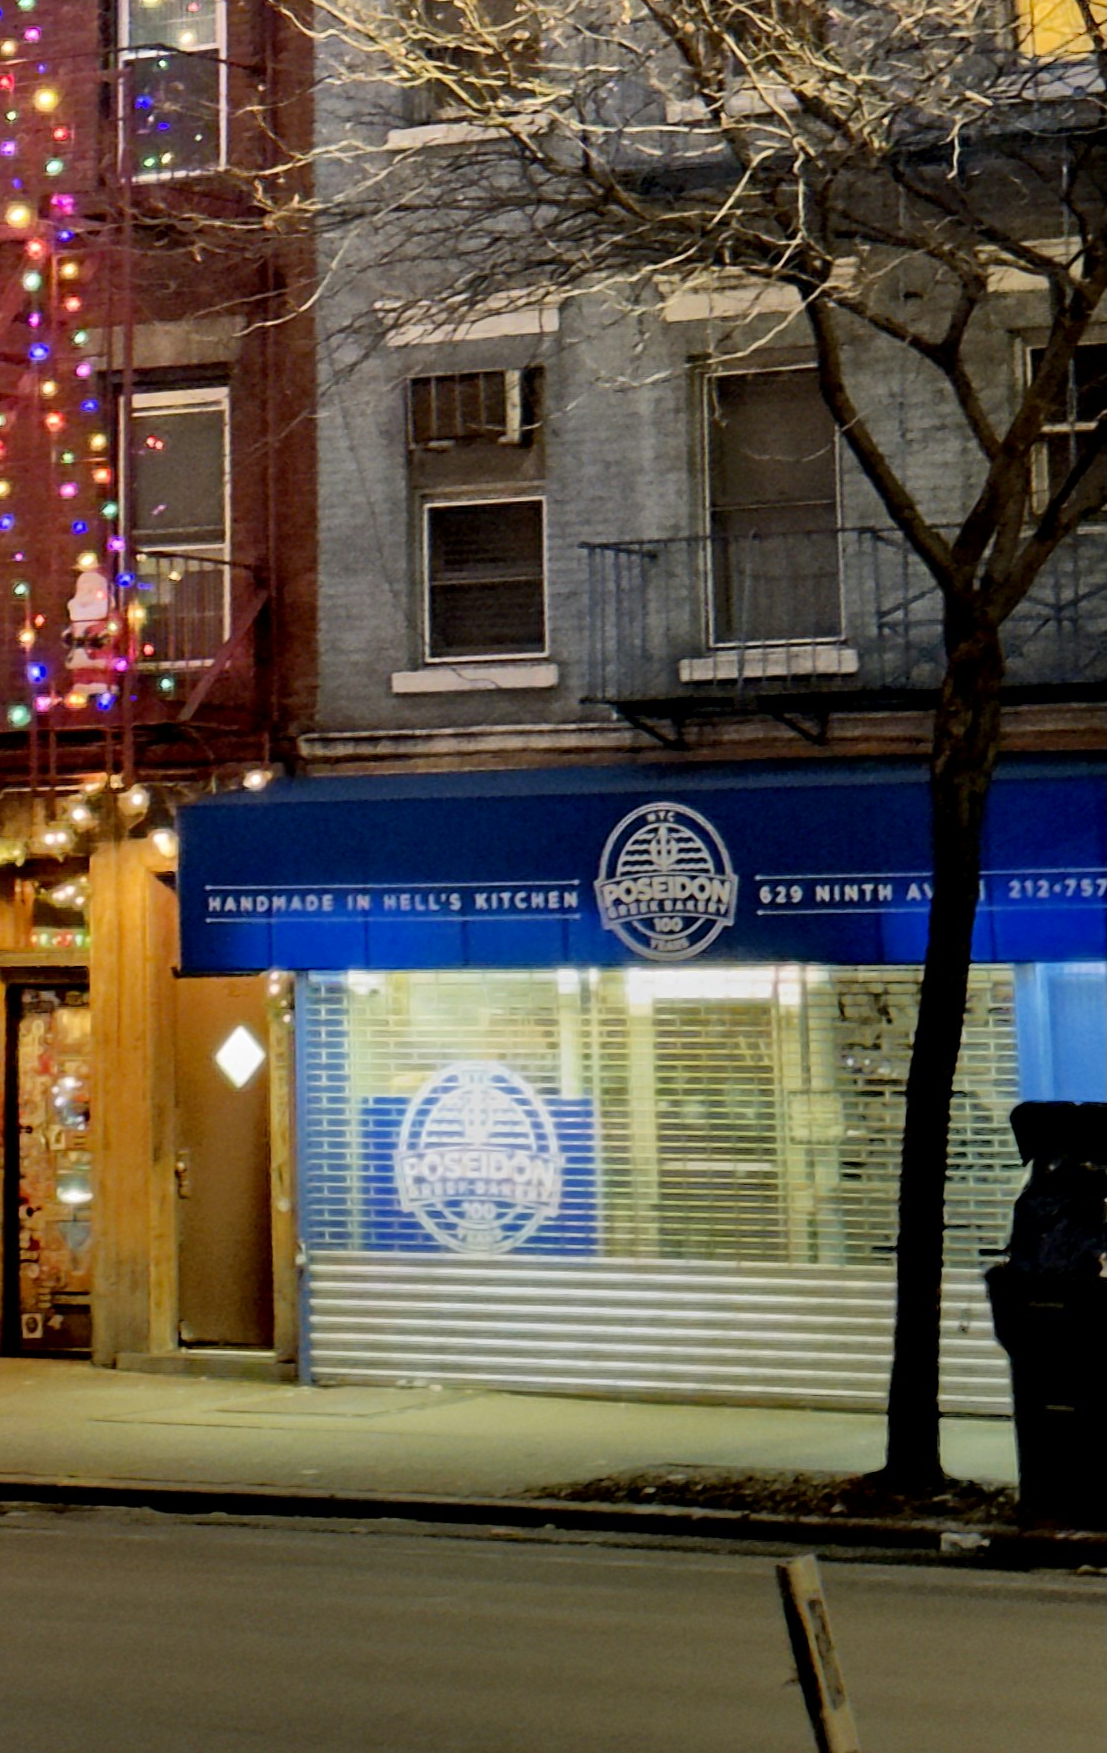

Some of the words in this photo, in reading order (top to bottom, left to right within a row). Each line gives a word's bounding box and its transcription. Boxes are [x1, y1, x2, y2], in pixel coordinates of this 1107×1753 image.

[207, 894, 334, 913] HANDMADE
[347, 893, 370, 911] IN
[383, 892, 462, 911] HELL'S
[475, 890, 579, 910] KITCHEN
[602, 876, 732, 908] POSEIDON
[759, 884, 803, 904] 629
[815, 883, 893, 903] NINTH
[905, 882, 935, 901] AV
[653, 916, 684, 933] 100
[402, 1151, 556, 1187] POSEIDON
